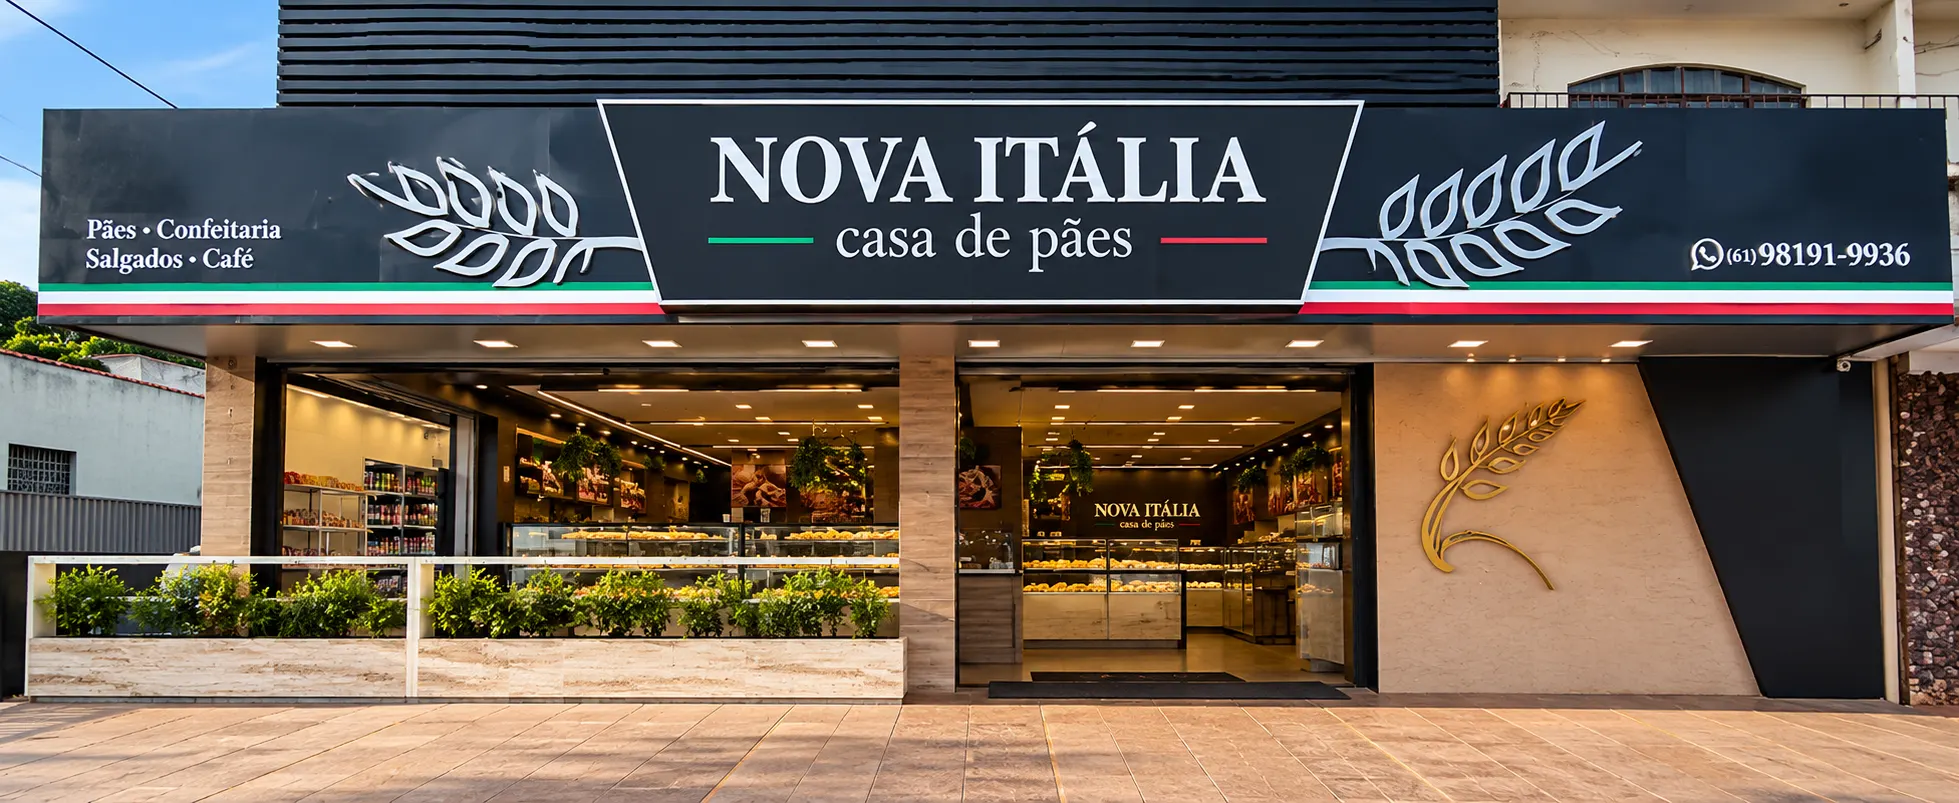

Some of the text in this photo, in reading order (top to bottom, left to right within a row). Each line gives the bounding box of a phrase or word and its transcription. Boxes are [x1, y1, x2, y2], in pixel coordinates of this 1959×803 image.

[710, 121, 1267, 204] NOVA ITÁLIA
[86, 217, 282, 241] Pães Confeitaria
[836, 212, 1133, 273] casa de pães
[85, 246, 254, 274] Salgados Café
[1094, 499, 1201, 518] NOVA ITÁLIA
[1119, 521, 1139, 529] casa
[1141, 519, 1153, 529] de
